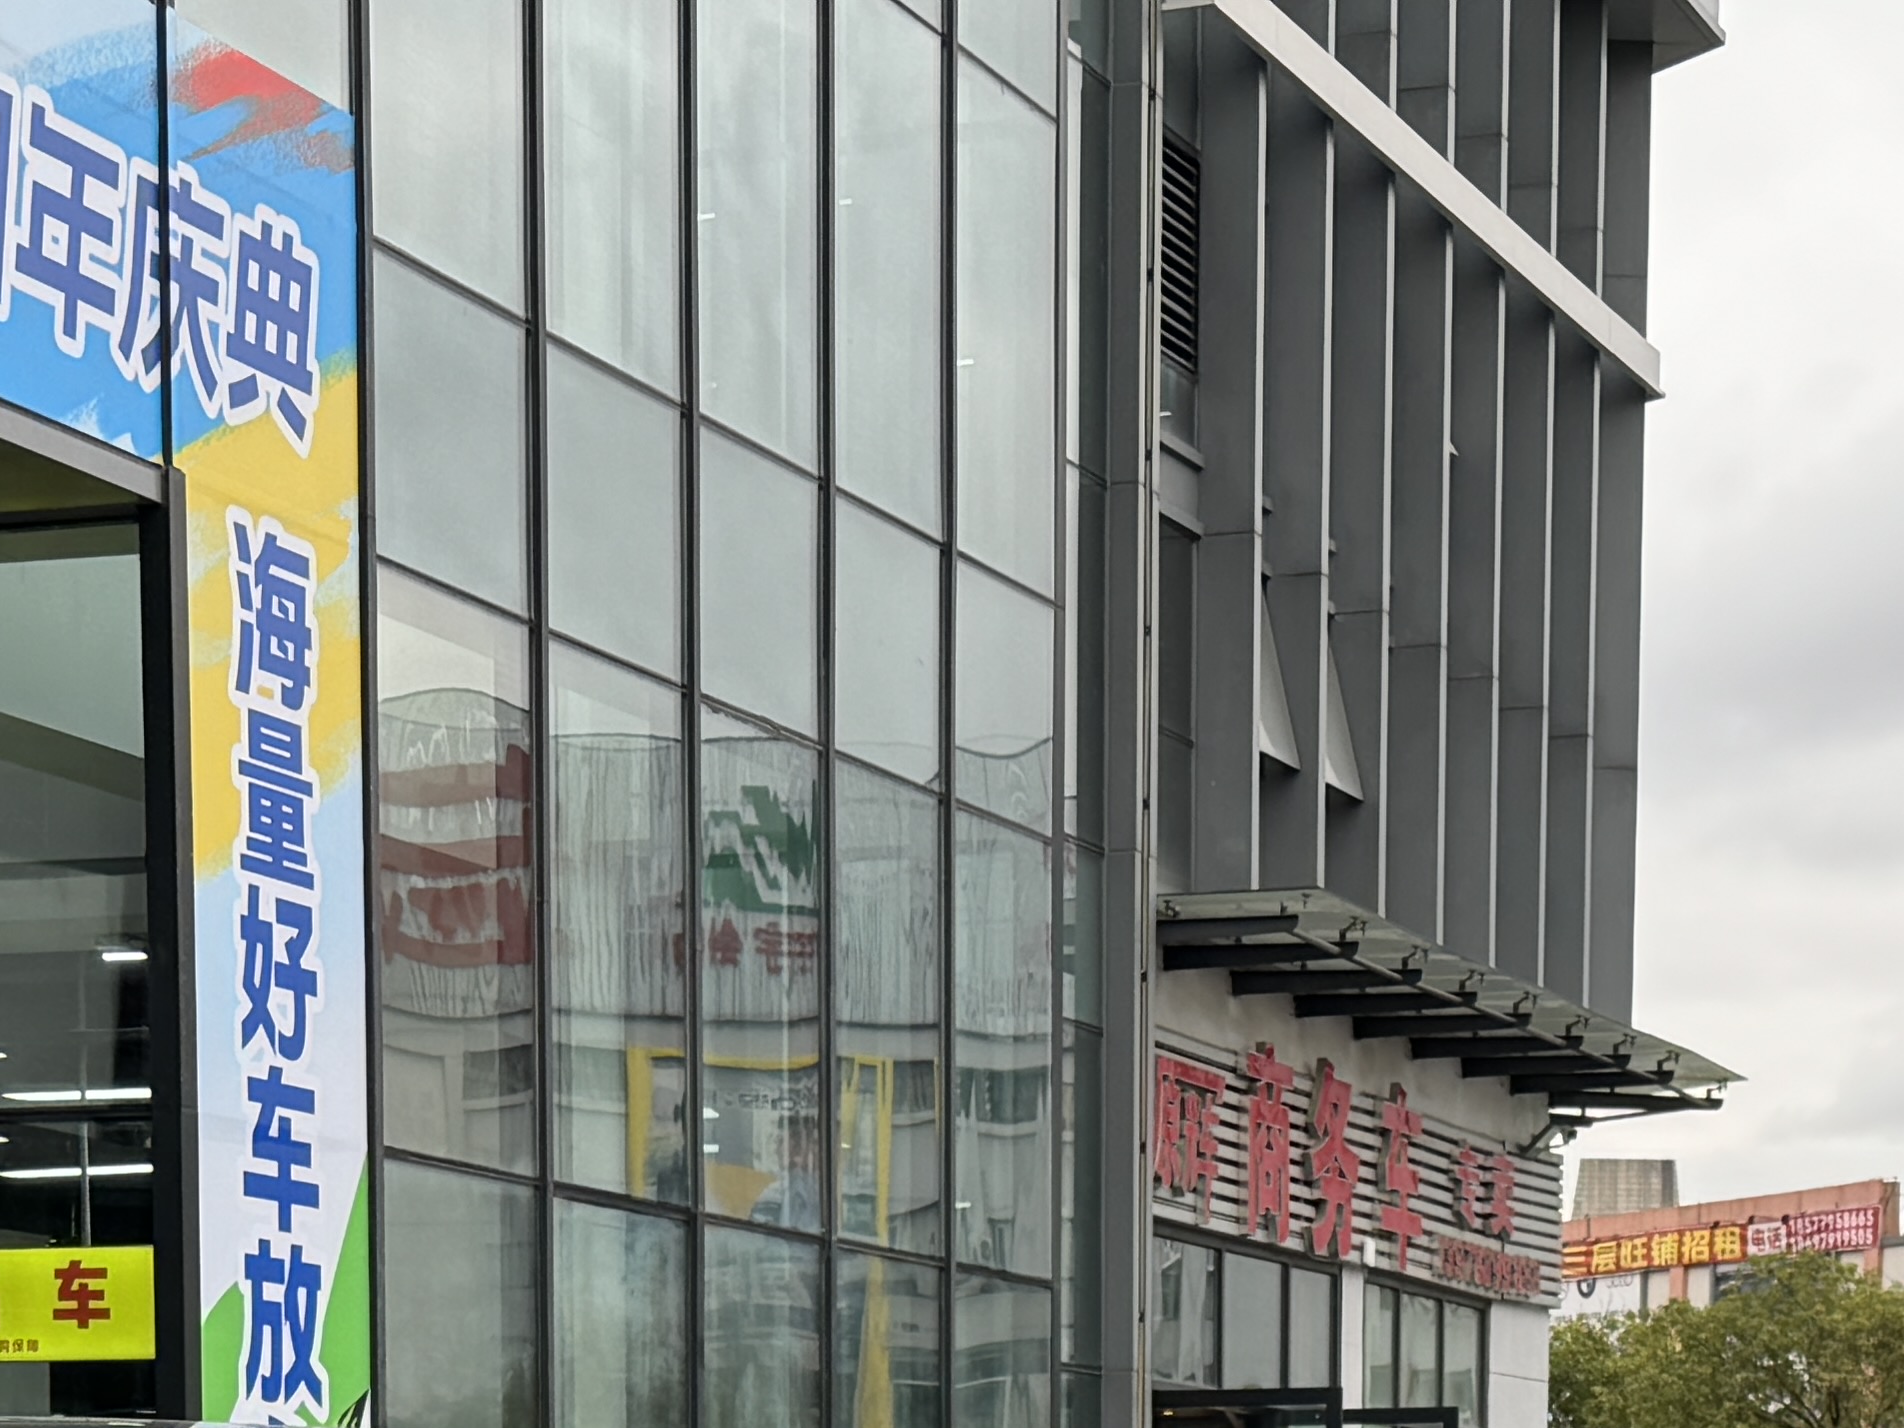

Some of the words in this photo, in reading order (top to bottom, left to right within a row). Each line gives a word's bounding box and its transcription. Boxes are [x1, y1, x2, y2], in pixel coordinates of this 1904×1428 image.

[233, 521, 322, 1427] 海量好车放
[1562, 1226, 1742, 1276] 三层旺铺招租
